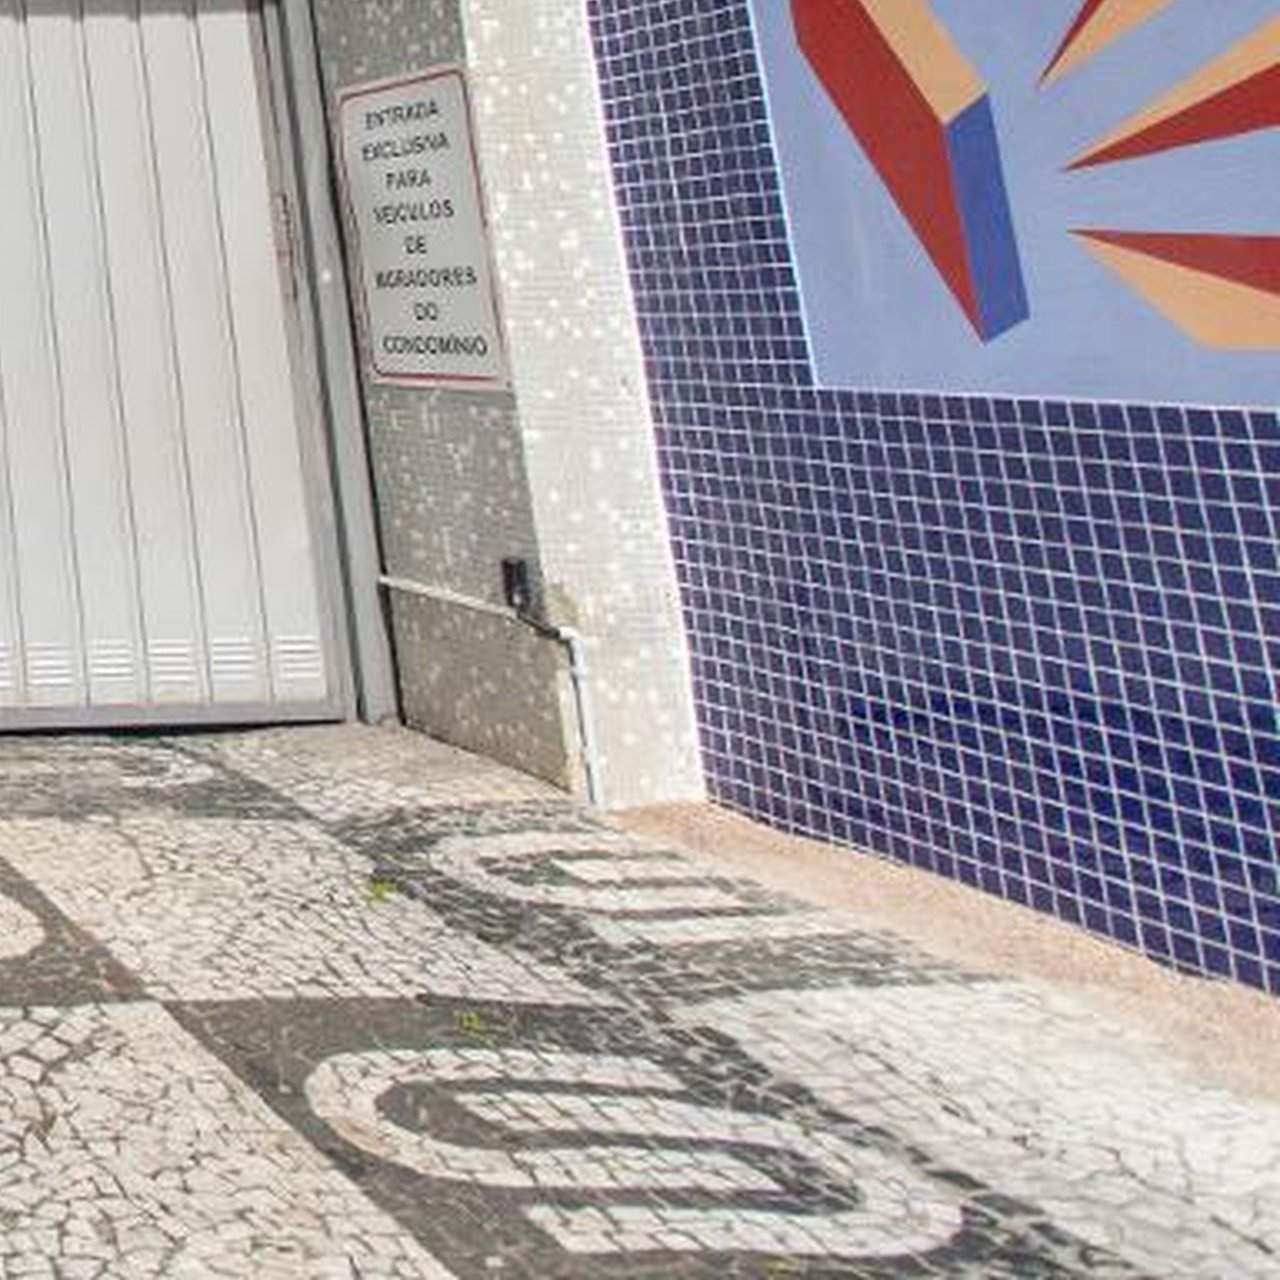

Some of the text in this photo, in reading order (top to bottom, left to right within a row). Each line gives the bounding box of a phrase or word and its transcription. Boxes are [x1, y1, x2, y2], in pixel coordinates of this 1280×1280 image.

[365, 99, 439, 131] ENTRADA
[361, 132, 450, 162] EXCLUSIVA
[385, 170, 432, 191] PARA
[404, 236, 428, 255] DE
[375, 265, 478, 290] MORADORES
[412, 302, 439, 322] DO
